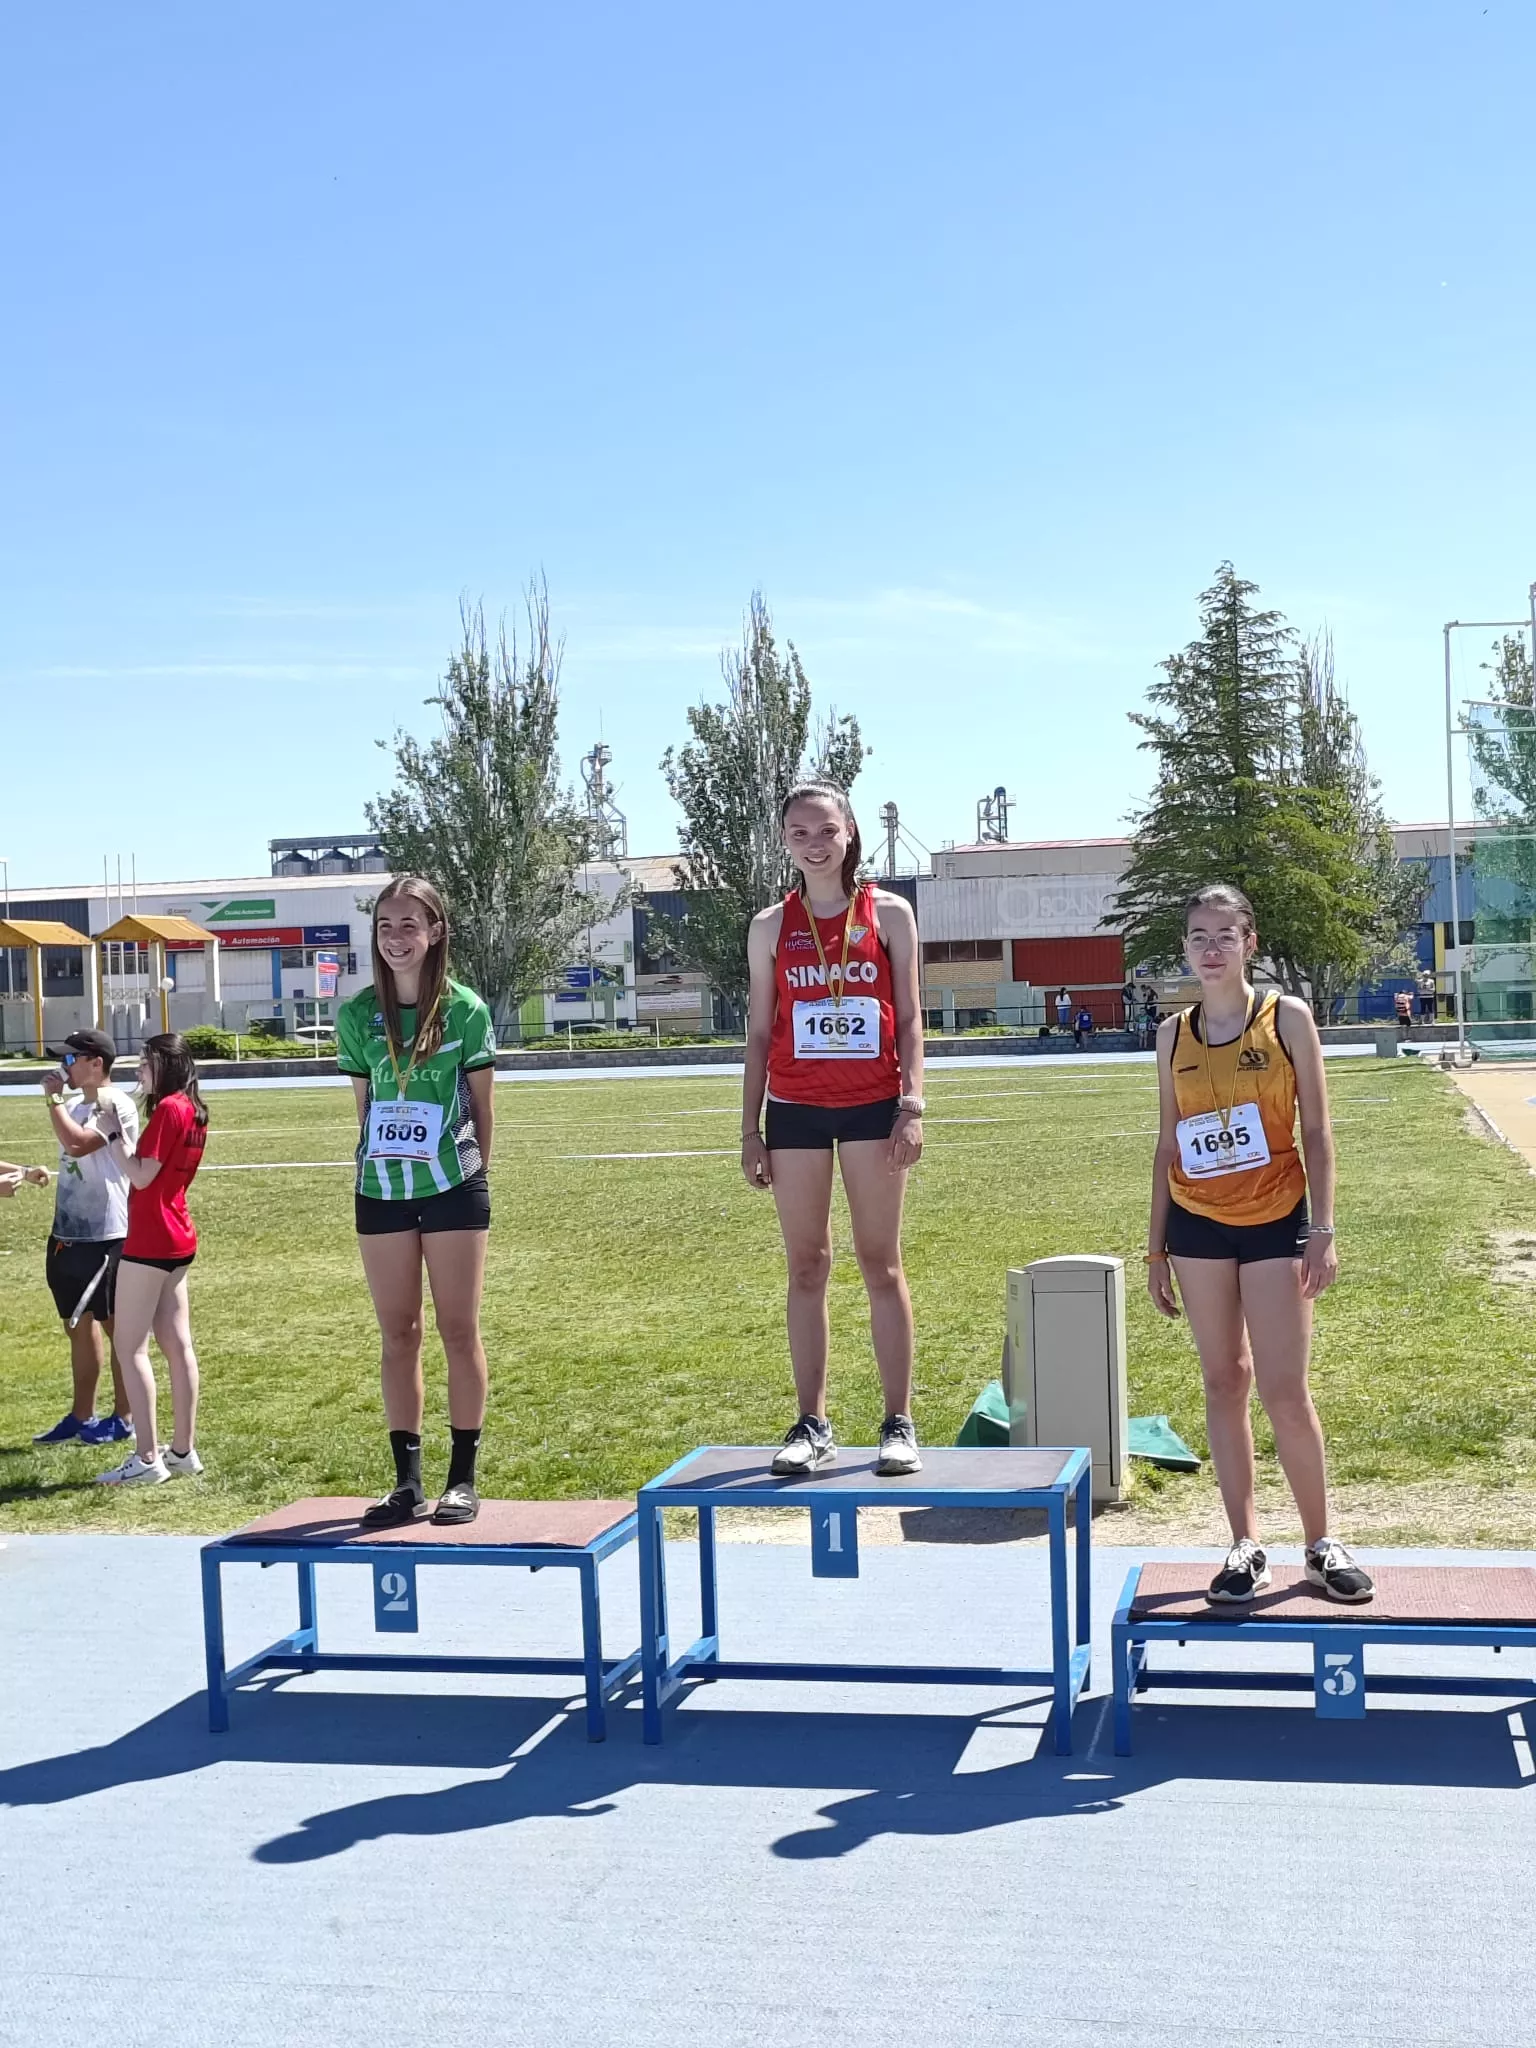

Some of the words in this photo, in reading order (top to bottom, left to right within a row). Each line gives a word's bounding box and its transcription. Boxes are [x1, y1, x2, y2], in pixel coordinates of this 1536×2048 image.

[784, 960, 878, 989] HINACO
[804, 1016, 866, 1036] 1662
[1190, 1126, 1251, 1156] 1695
[822, 1512, 844, 1552] 1
[380, 1572, 409, 1611] 2
[1323, 1653, 1357, 1696] 3
